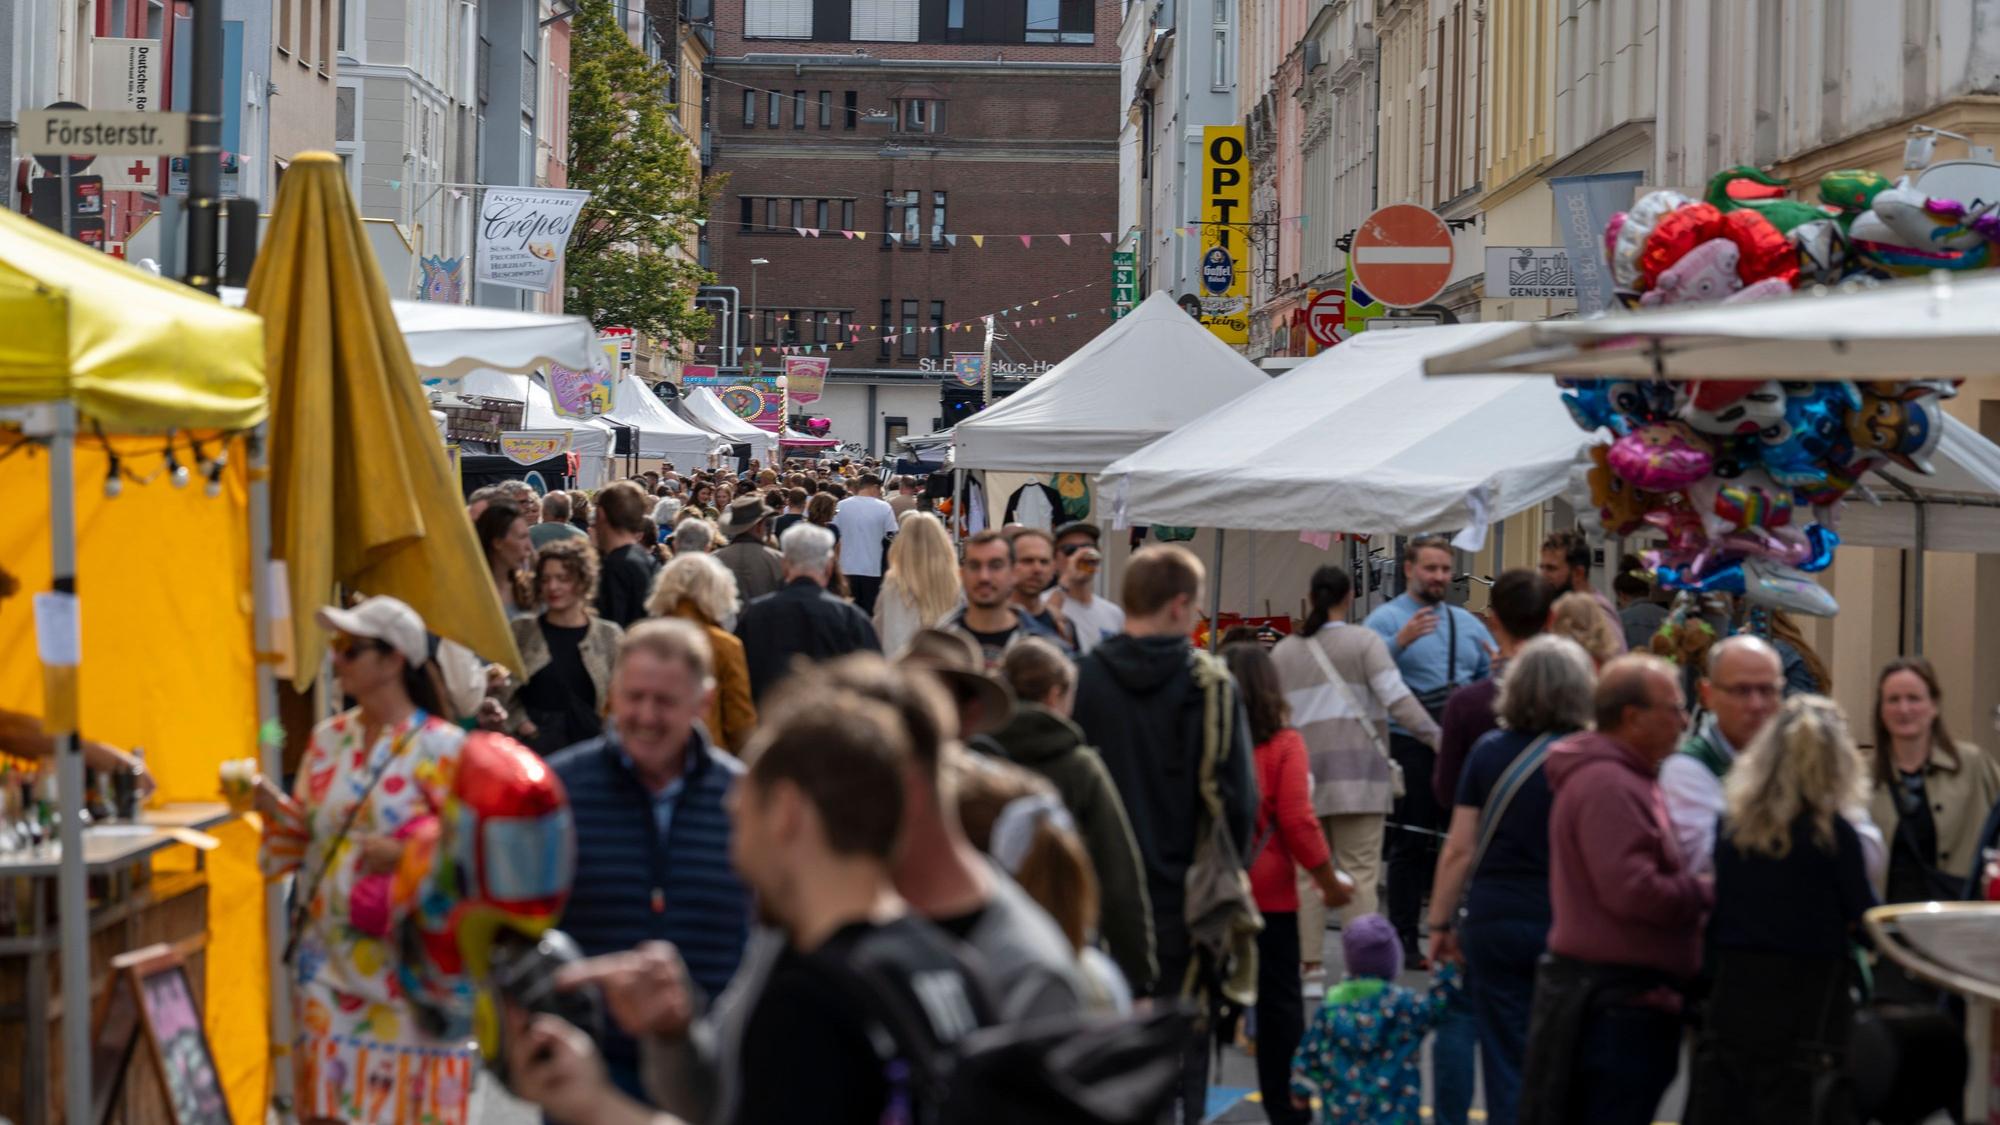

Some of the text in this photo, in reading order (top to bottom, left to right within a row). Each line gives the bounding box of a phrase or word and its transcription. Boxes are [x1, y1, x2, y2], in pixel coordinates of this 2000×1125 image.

[137, 47, 149, 93] Deutsches
[45, 119, 164, 145] Försterstr.
[483, 202, 573, 251] Crêpes
[1210, 136, 1243, 286] OPTI
[1203, 265, 1231, 276] Gaffel
[919, 357, 941, 373] St.
